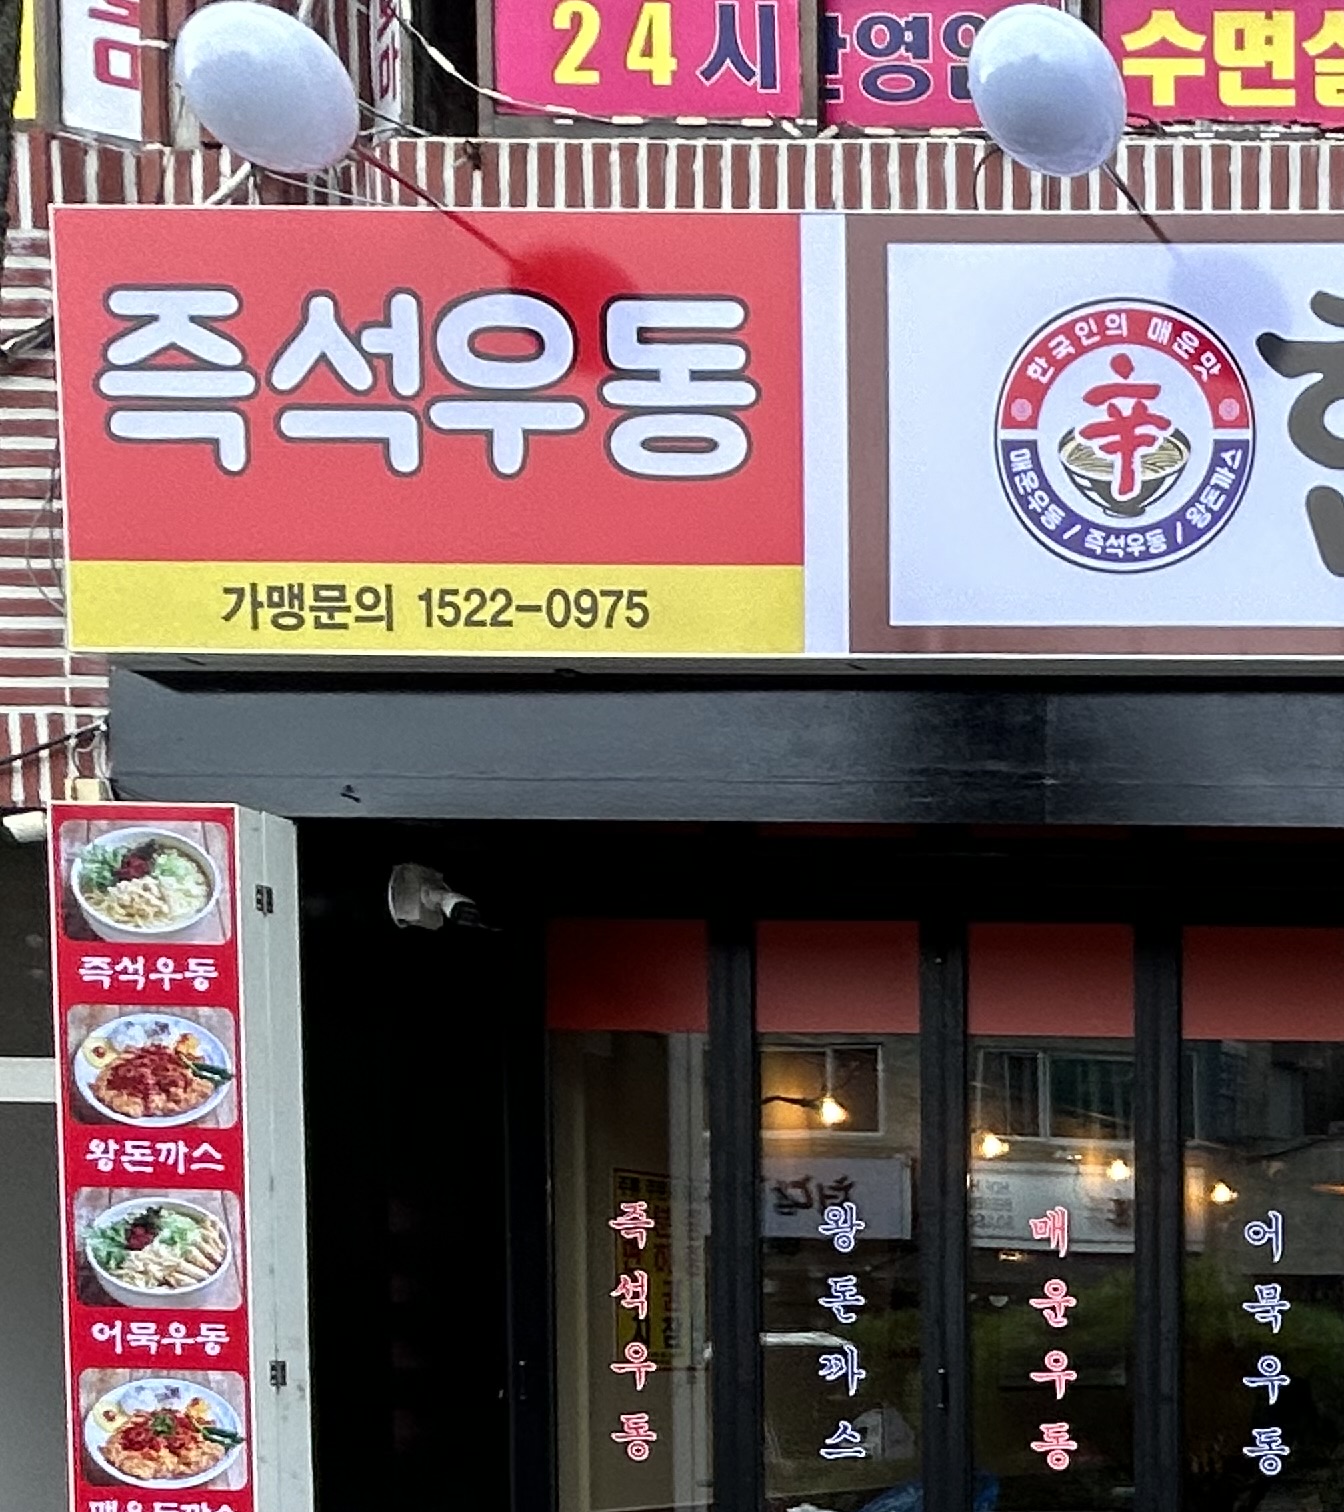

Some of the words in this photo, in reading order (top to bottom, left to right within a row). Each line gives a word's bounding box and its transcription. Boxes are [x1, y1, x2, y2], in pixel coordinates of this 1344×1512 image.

[552, 0, 780, 94] 24시
[94, 283, 761, 478] 즉석우동
[1026, 313, 1128, 384] 한국인의
[1146, 316, 1223, 382] 매운맛
[1082, 352, 1172, 496] 辛
[1009, 448, 1067, 531] 매운우동
[1084, 528, 1167, 558] 즉석우동
[1185, 449, 1242, 530] 왕돈까스
[221, 583, 395, 632] 가맹문의
[417, 587, 650, 631] 1522-0975
[78, 955, 219, 992] 즉석우동
[85, 1139, 225, 1175] 왕돈까스
[91, 1321, 230, 1357] 어묵우동
[608, 1200, 657, 1463] 즉석우동
[818, 1200, 867, 1462] 왕돈까스
[1028, 1205, 1078, 1471] 매운우동
[1241, 1210, 1291, 1476] 어묵우동
